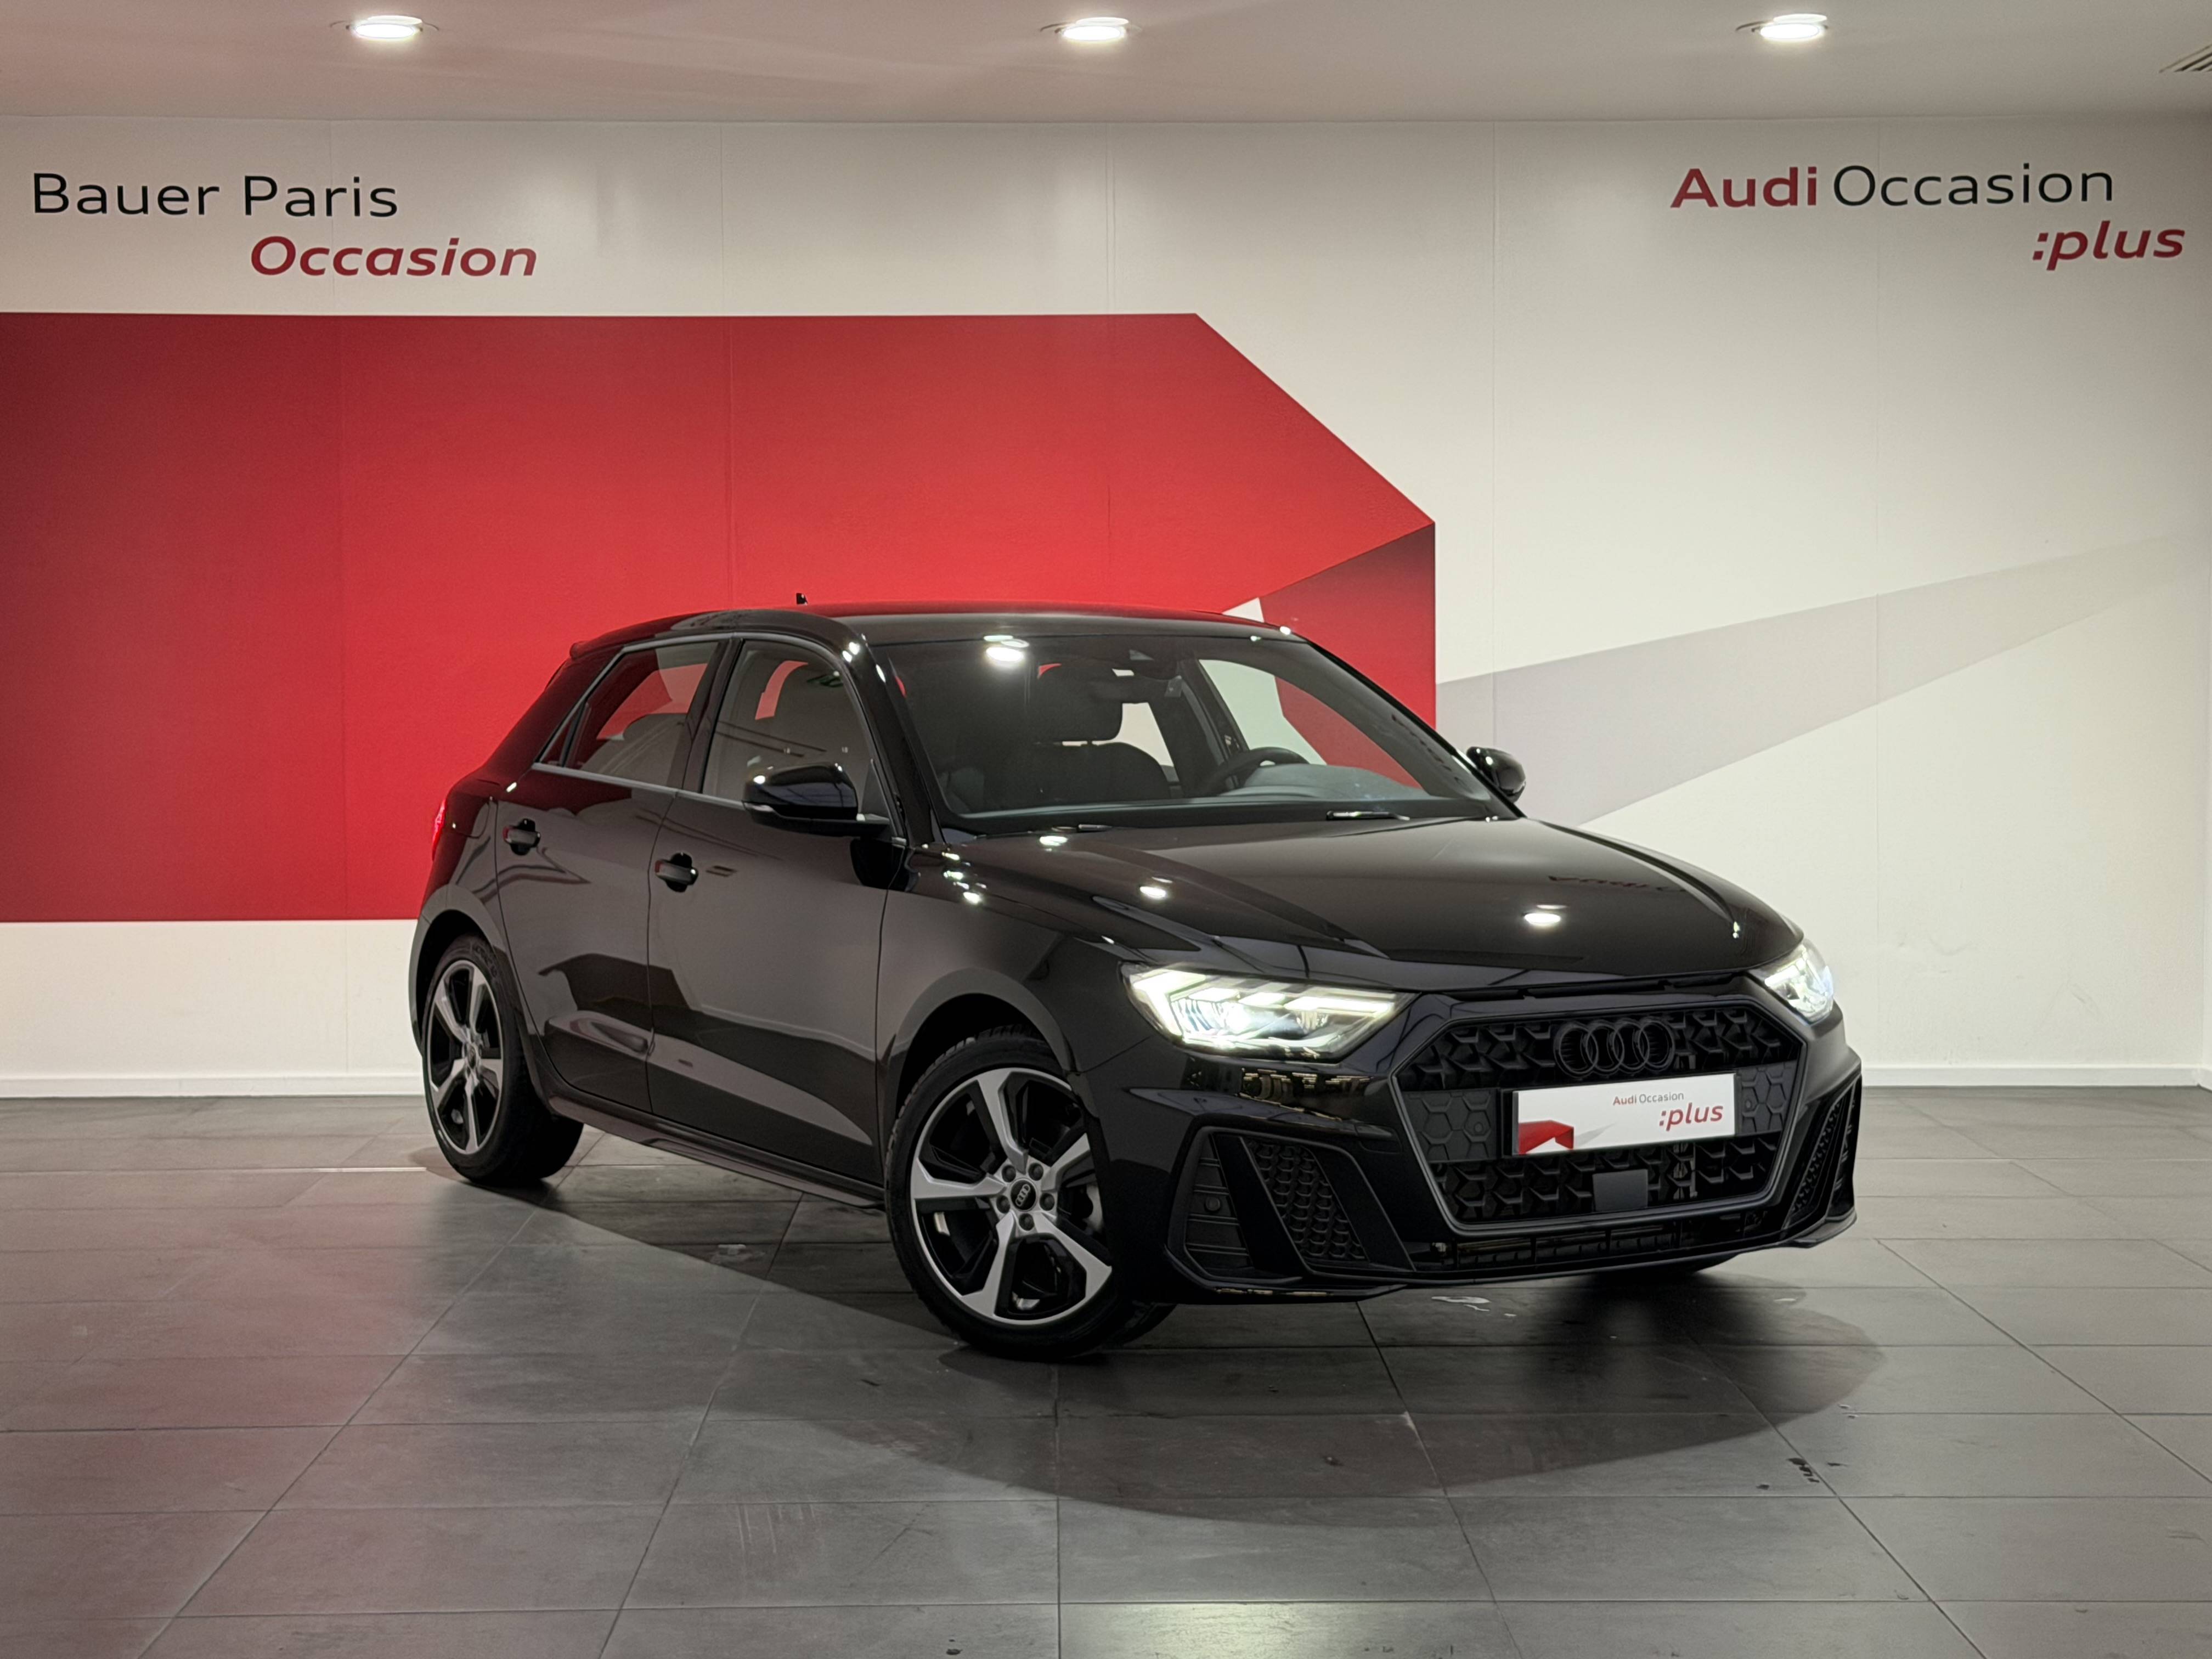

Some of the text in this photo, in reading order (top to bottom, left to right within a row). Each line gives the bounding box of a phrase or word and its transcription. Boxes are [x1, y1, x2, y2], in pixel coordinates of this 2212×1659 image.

[33, 172, 398, 218] Bauer Paris
[1671, 162, 2113, 208] Audi Occasion
[251, 235, 537, 277] Occasion
[2032, 219, 2186, 271] :plus
[1612, 1092, 1685, 1105] Audi Occasion
[1658, 1102, 1724, 1132] :plus
